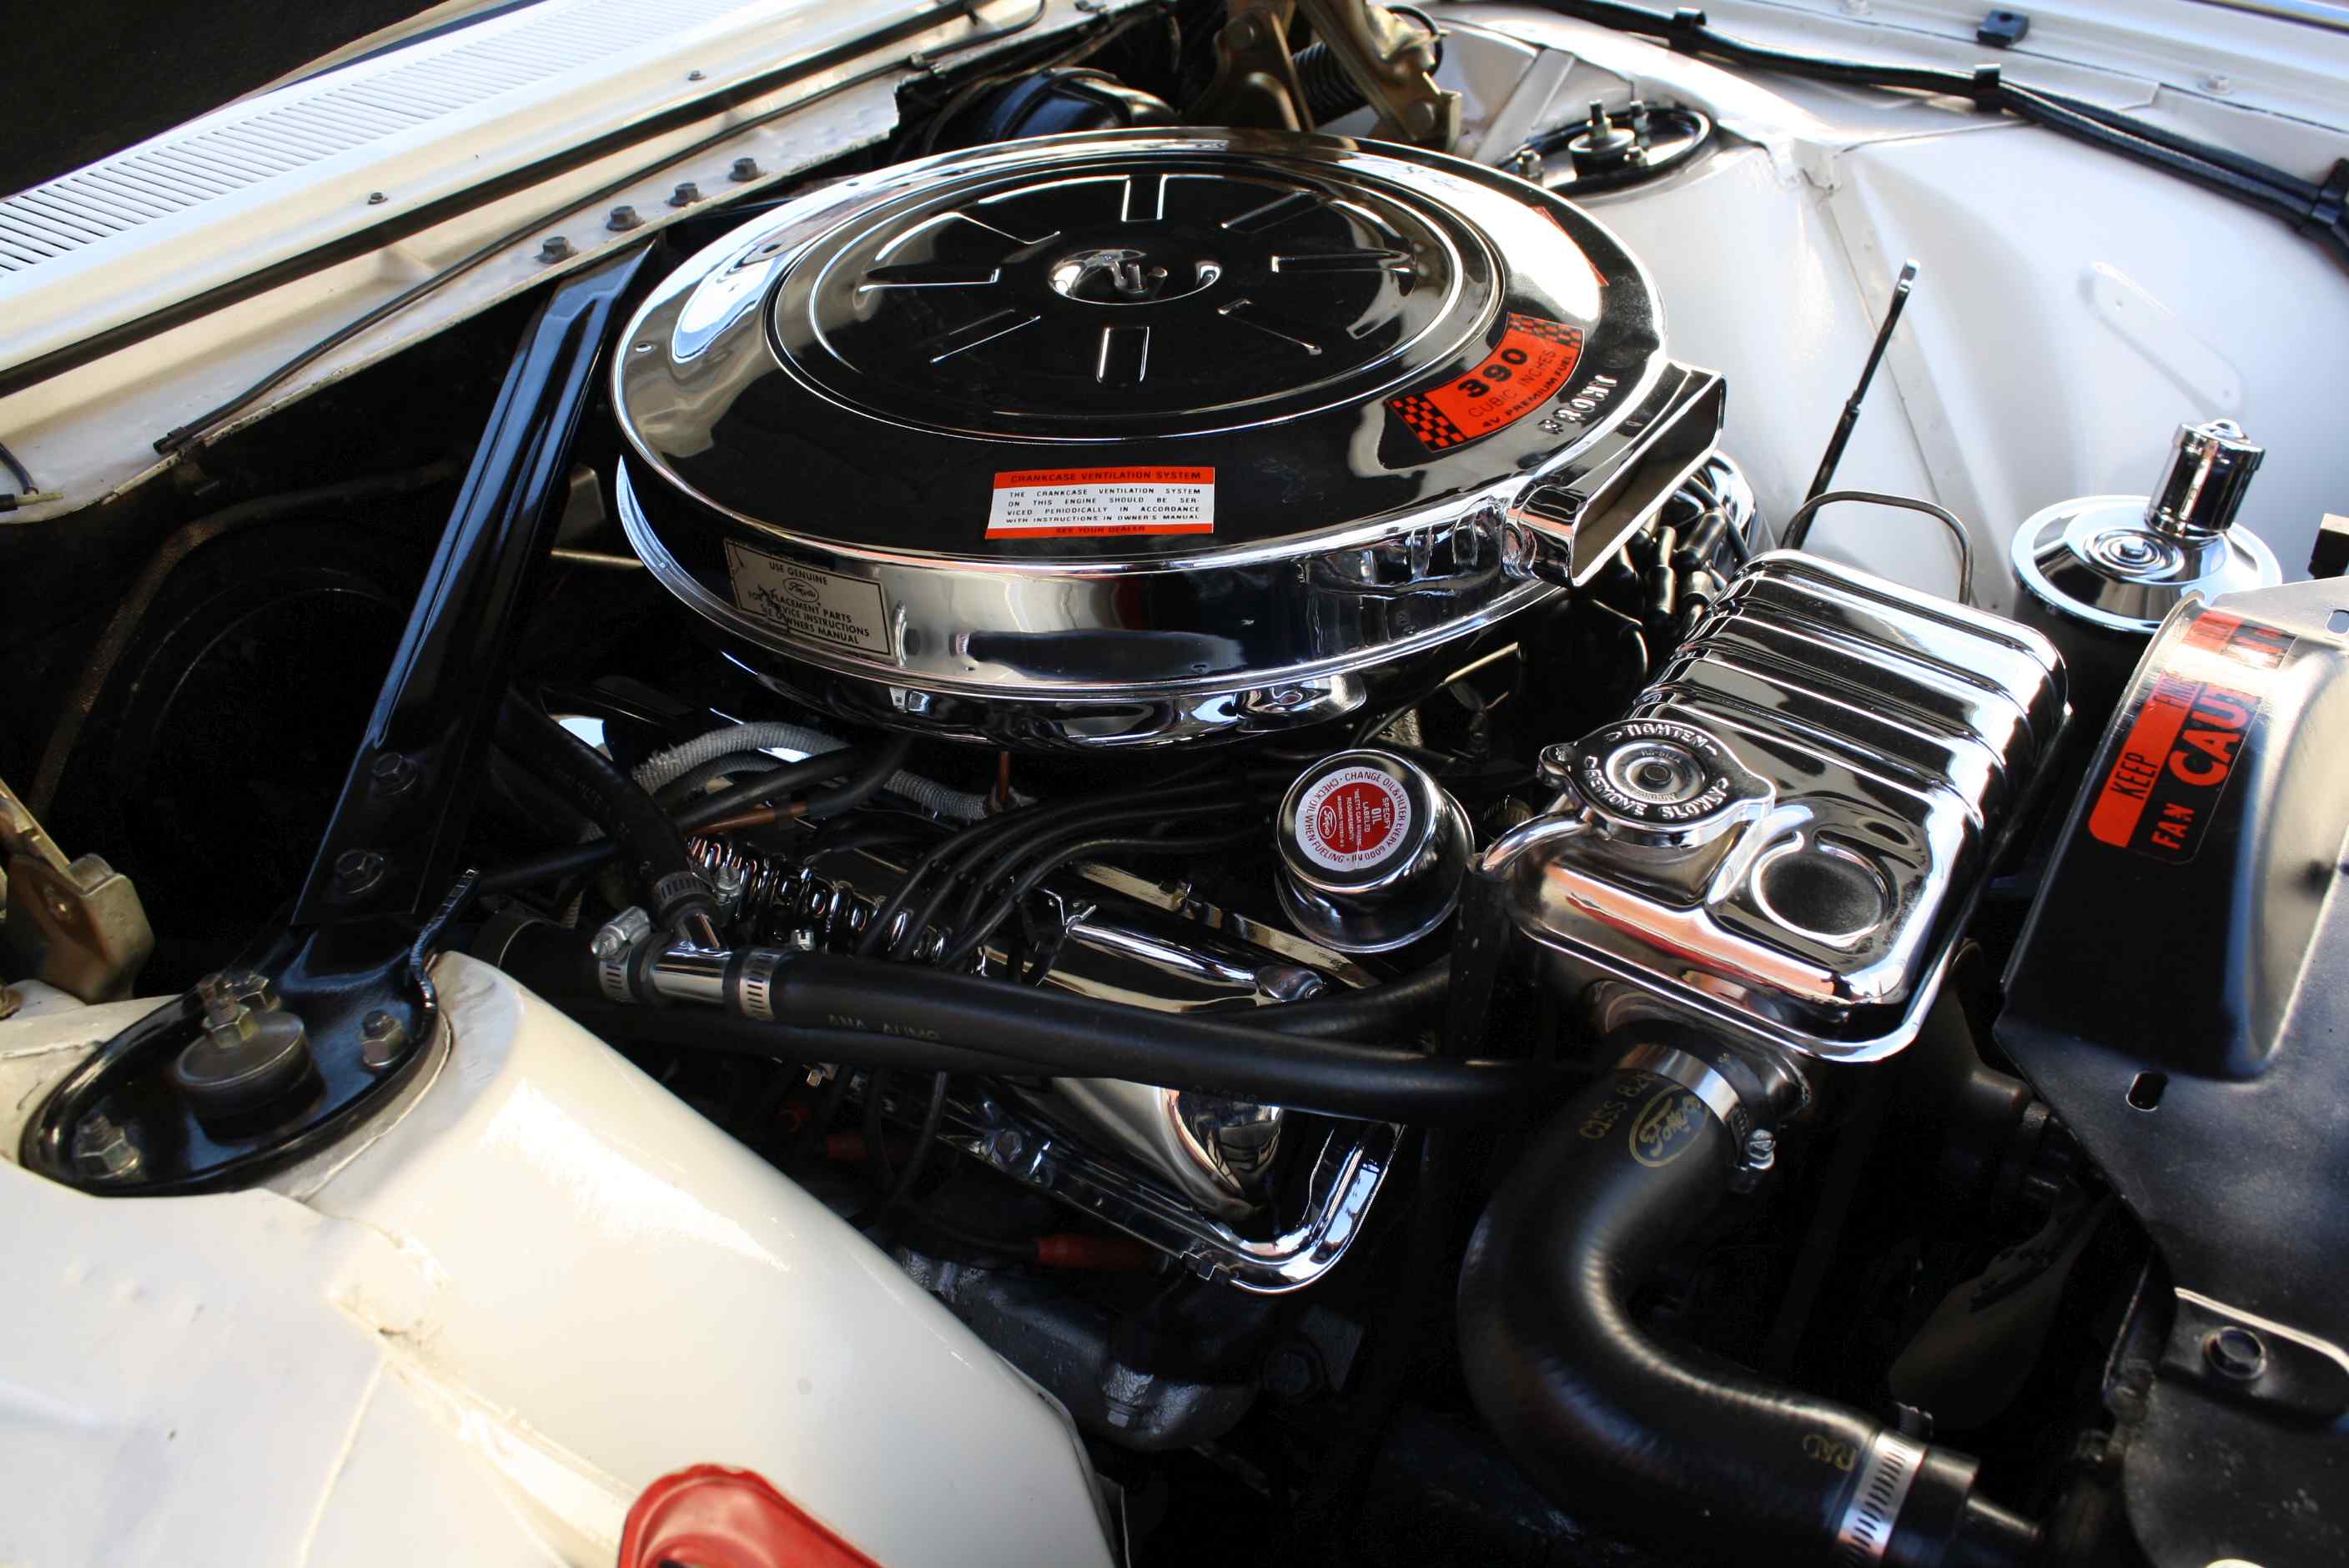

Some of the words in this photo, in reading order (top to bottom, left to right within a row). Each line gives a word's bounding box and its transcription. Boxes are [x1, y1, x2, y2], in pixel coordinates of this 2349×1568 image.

[1457, 348, 1561, 398] 390
[1468, 390, 1517, 418] CUBIC
[1518, 349, 1557, 388] INCHES
[1481, 417, 1501, 427] 4V
[1505, 378, 1558, 416] PREMIUM
[1554, 355, 1572, 377] FUEL
[1010, 472, 1076, 483] CRANKCASE
[1081, 471, 1151, 480] VENTILATION
[1155, 471, 1201, 480] SYSTEM
[1036, 489, 1088, 497] CRANKCASE
[1044, 506, 1108, 515] PERIODICALLY
[768, 561, 785, 574] USE
[787, 568, 828, 585] GENUINE
[804, 616, 870, 637] INSTRUCTIONS
[822, 609, 852, 624] PARTS
[817, 626, 860, 645] MANUAL
[1622, 722, 1709, 749] TIGHTEN
[1316, 778, 1340, 799] CHECK
[2110, 751, 2159, 801] KEEP
[1585, 767, 1648, 817] REMOVE
[1660, 785, 1727, 819] SLOWLY
[1306, 800, 1318, 814] OIL
[1345, 771, 1382, 782] CHANGE
[1386, 822, 1404, 848] EVERY
[1371, 807, 1383, 825] OIL
[1382, 797, 1391, 829] SPECIFY
[1305, 815, 1316, 842] WHEN
[2150, 802, 2196, 850] FAN
[1311, 837, 1346, 863] FUELING
